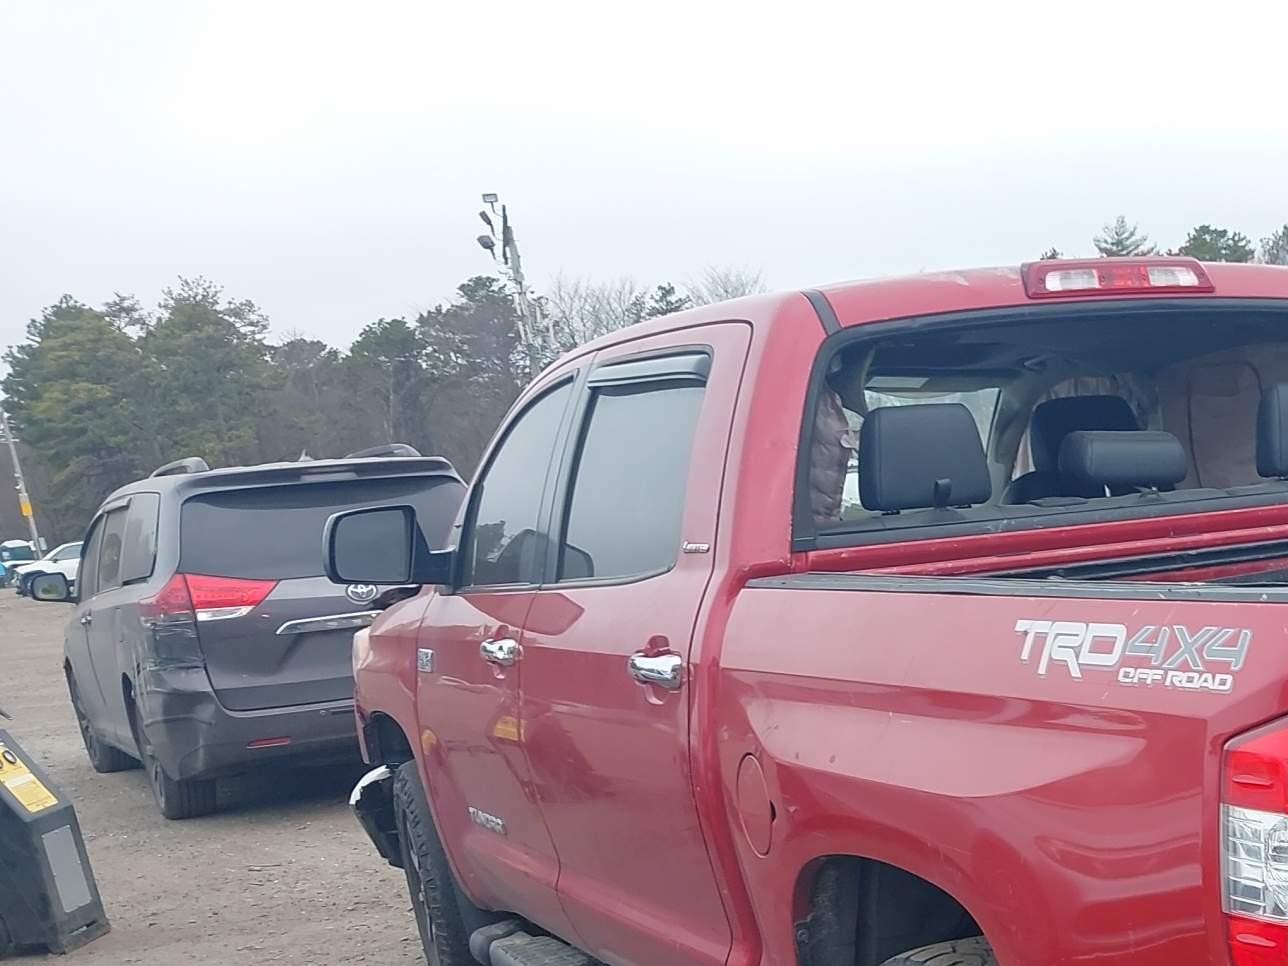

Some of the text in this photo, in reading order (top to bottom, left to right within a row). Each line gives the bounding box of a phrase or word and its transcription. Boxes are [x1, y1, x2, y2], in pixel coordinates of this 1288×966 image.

[1014, 619, 1128, 681] TRD
[1117, 666, 1234, 692] OFF ROAD
